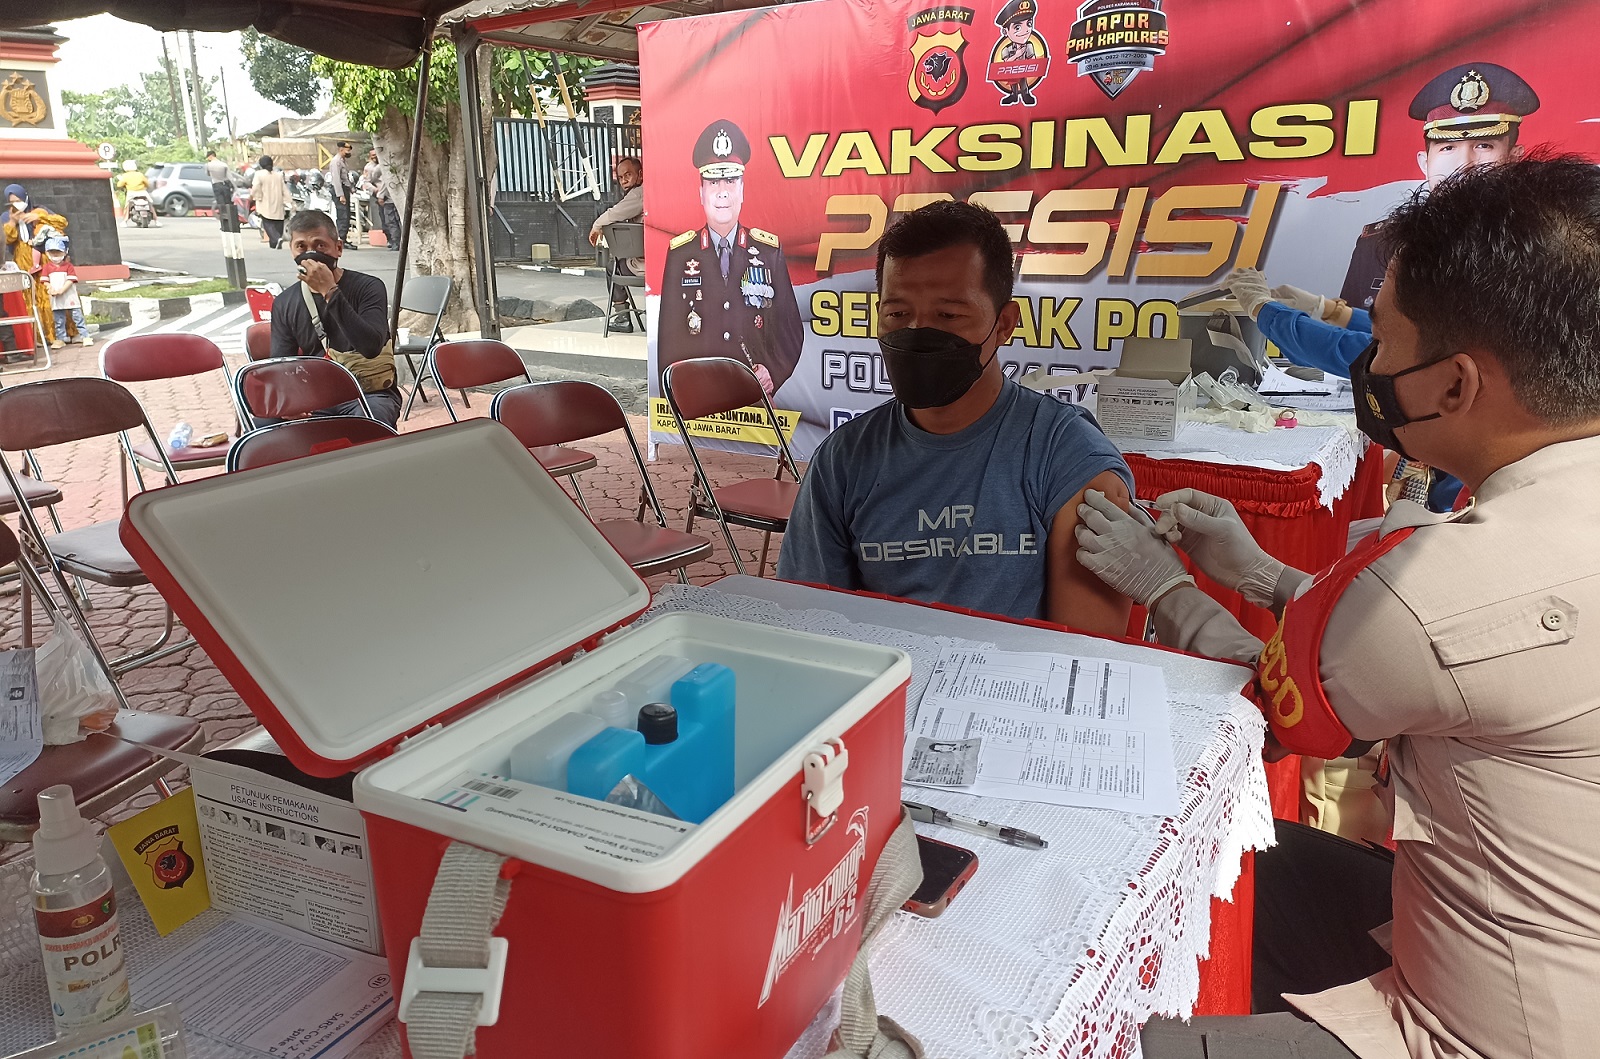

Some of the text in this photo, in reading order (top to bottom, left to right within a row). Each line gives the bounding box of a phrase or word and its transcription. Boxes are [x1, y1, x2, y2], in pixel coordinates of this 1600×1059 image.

[912, 10, 970, 28] JAWA BARAT
[1085, 13, 1149, 35] LAPOR
[1065, 30, 1169, 55] PAK KAPOLRES
[997, 64, 1039, 75] PRESISI
[769, 99, 1379, 178] VAKSINASI
[693, 423, 714, 433] JAWA
[715, 425, 741, 435] BARAT
[918, 504, 974, 532] MR
[859, 533, 1037, 562] DESIRABLE
[231, 784, 319, 814] PETUNJUK PEMAKAIAN
[231, 795, 319, 823] USAGE INSTRUCTIONS
[139, 828, 176, 852] JAWA BARAT
[278, 1027, 305, 1046] spike
